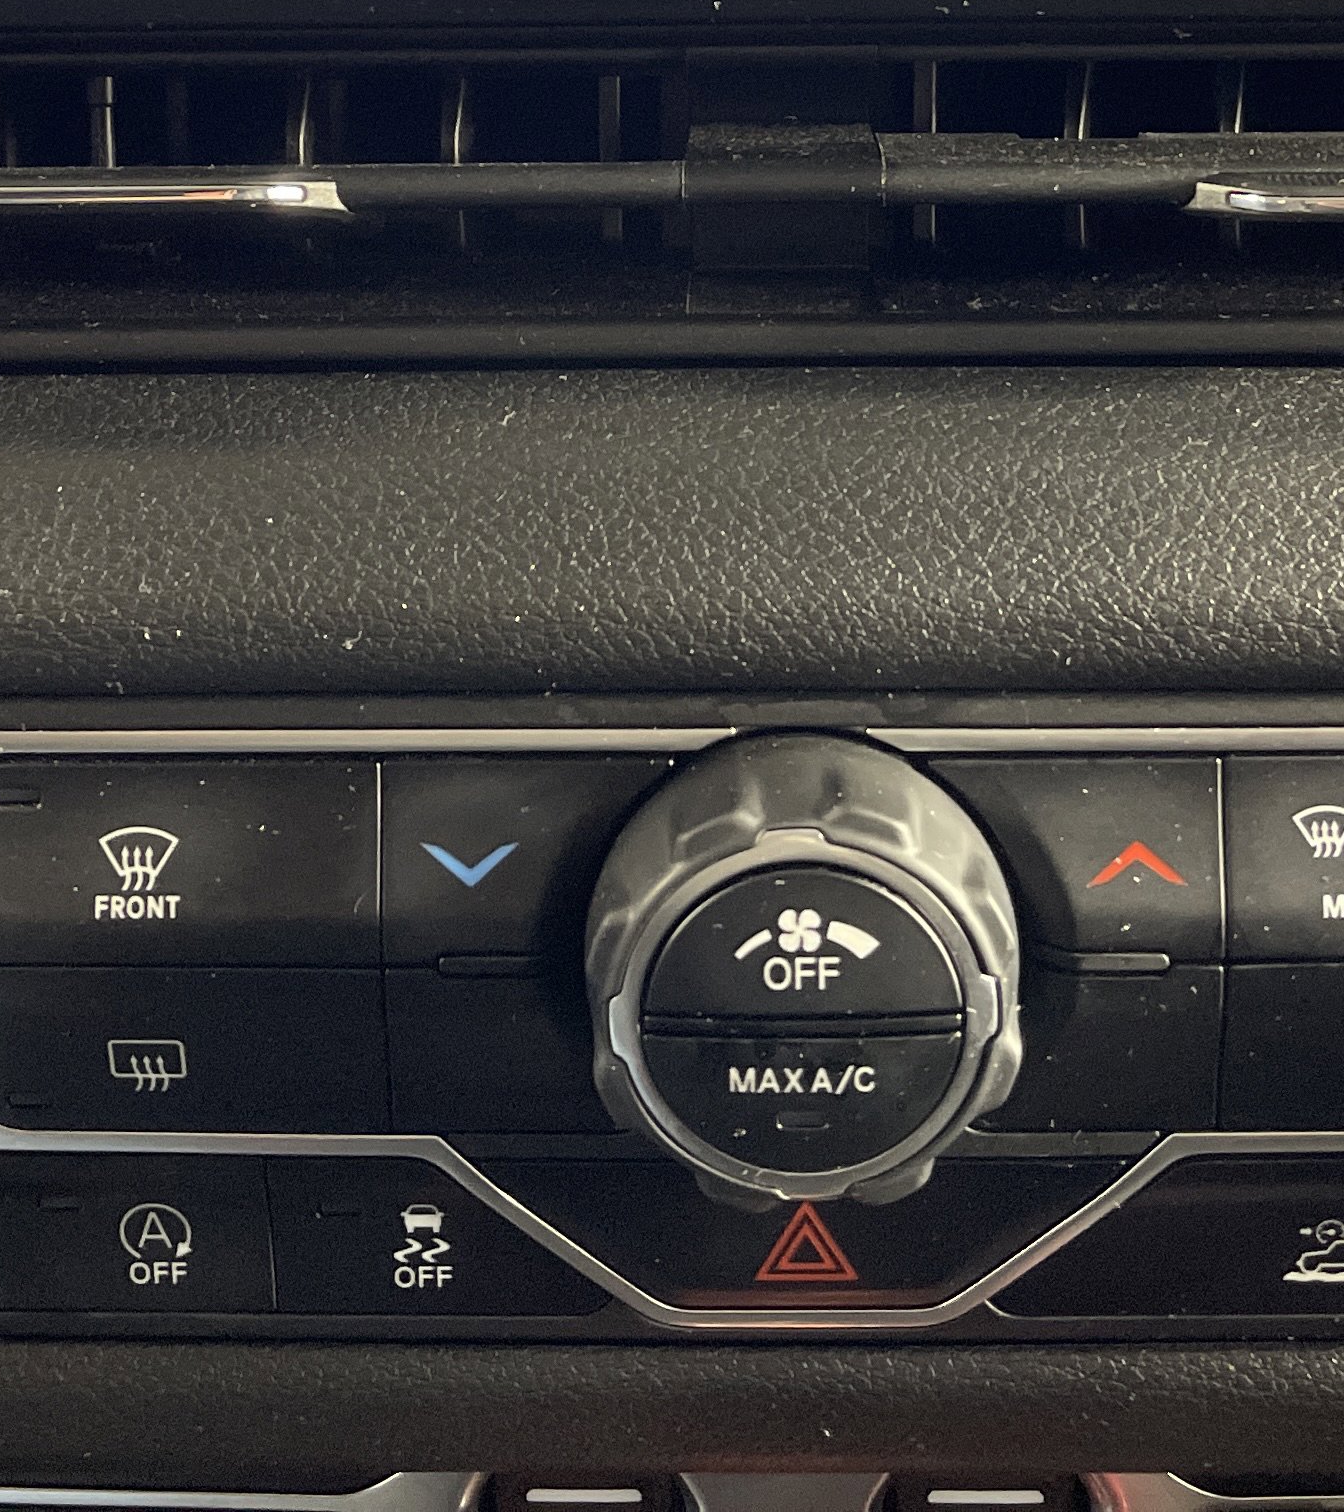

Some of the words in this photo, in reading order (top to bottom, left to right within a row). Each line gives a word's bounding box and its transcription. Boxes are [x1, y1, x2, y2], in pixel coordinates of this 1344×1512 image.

[94, 894, 181, 920] FRONT
[762, 955, 842, 991] OFF
[728, 1065, 804, 1094] MAX
[810, 1064, 876, 1095] A/C
[128, 1261, 188, 1285] OFF
[393, 1264, 453, 1289] OFF
